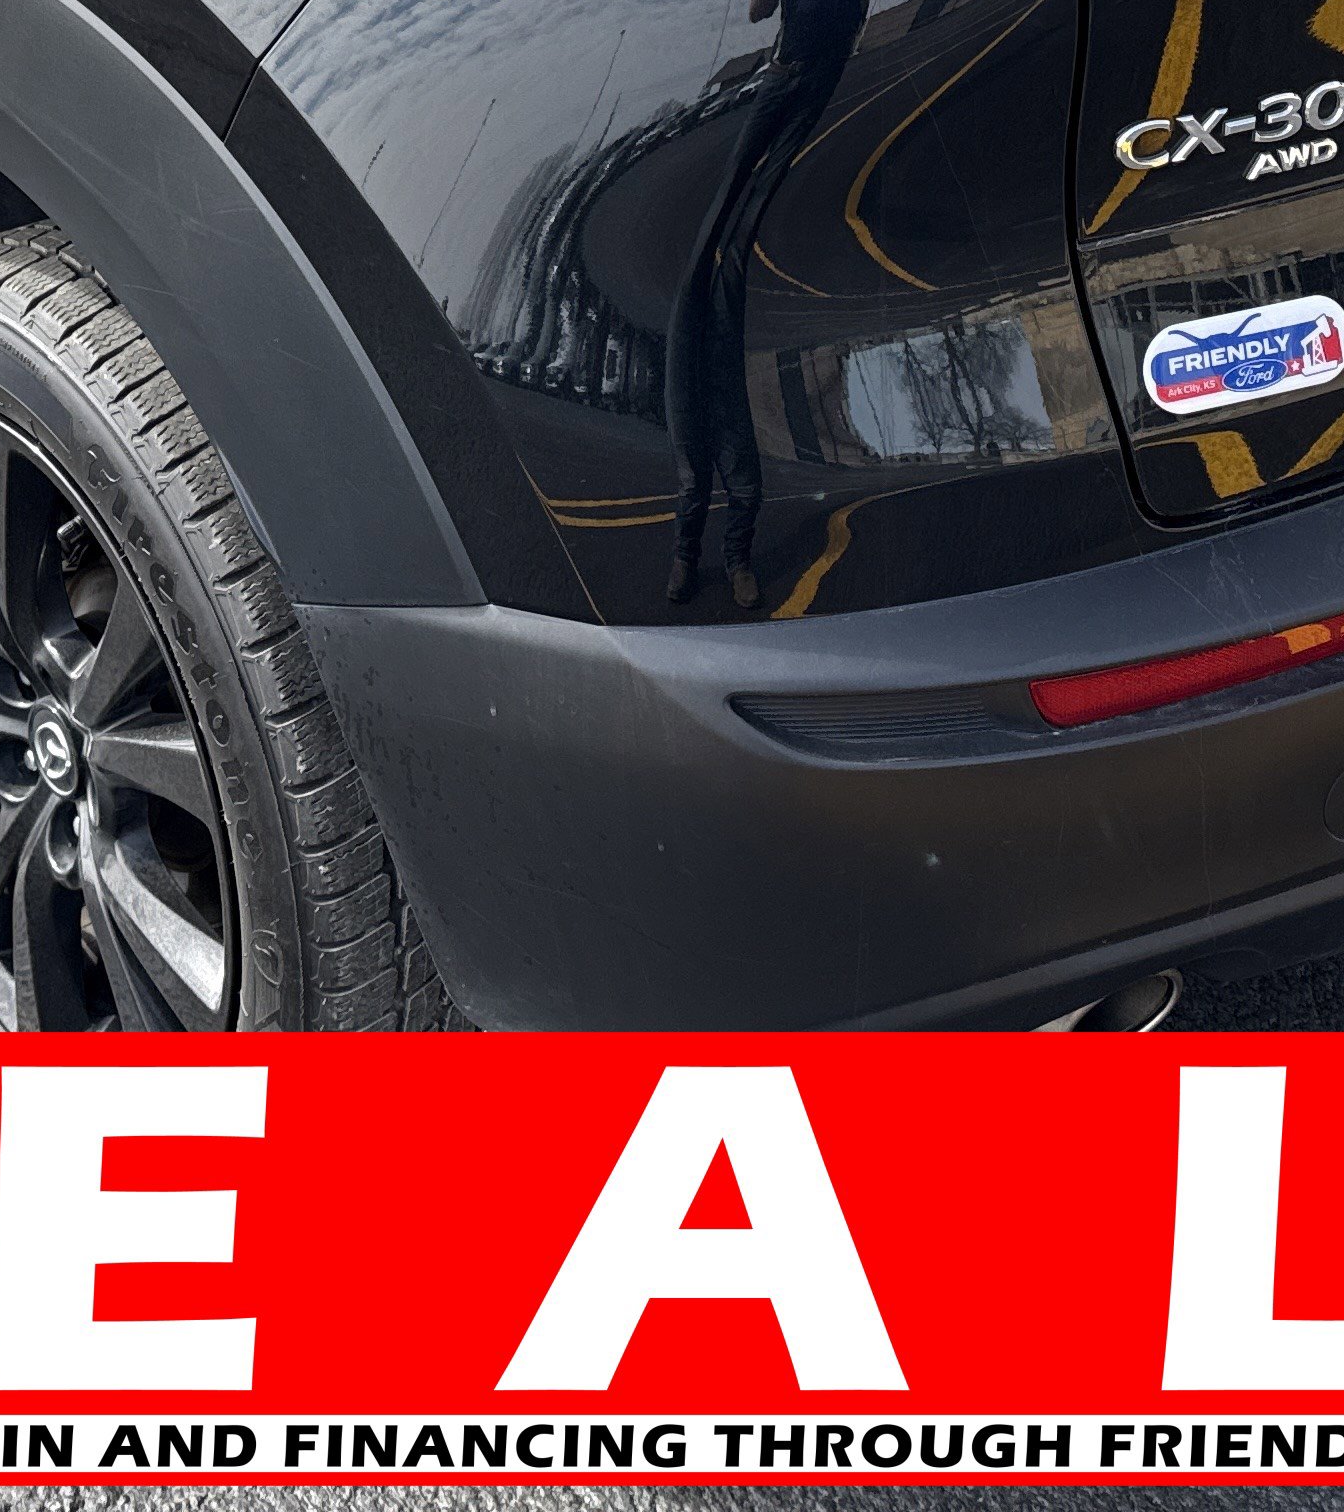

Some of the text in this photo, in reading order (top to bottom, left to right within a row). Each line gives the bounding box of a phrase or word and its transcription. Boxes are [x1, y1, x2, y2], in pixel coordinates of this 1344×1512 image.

[1244, 138, 1339, 181] AWD
[1169, 334, 1291, 376] FRIENDLY
[1168, 386, 1183, 398] Ark
[1203, 379, 1216, 390] KS
[1235, 363, 1277, 387] Ford
